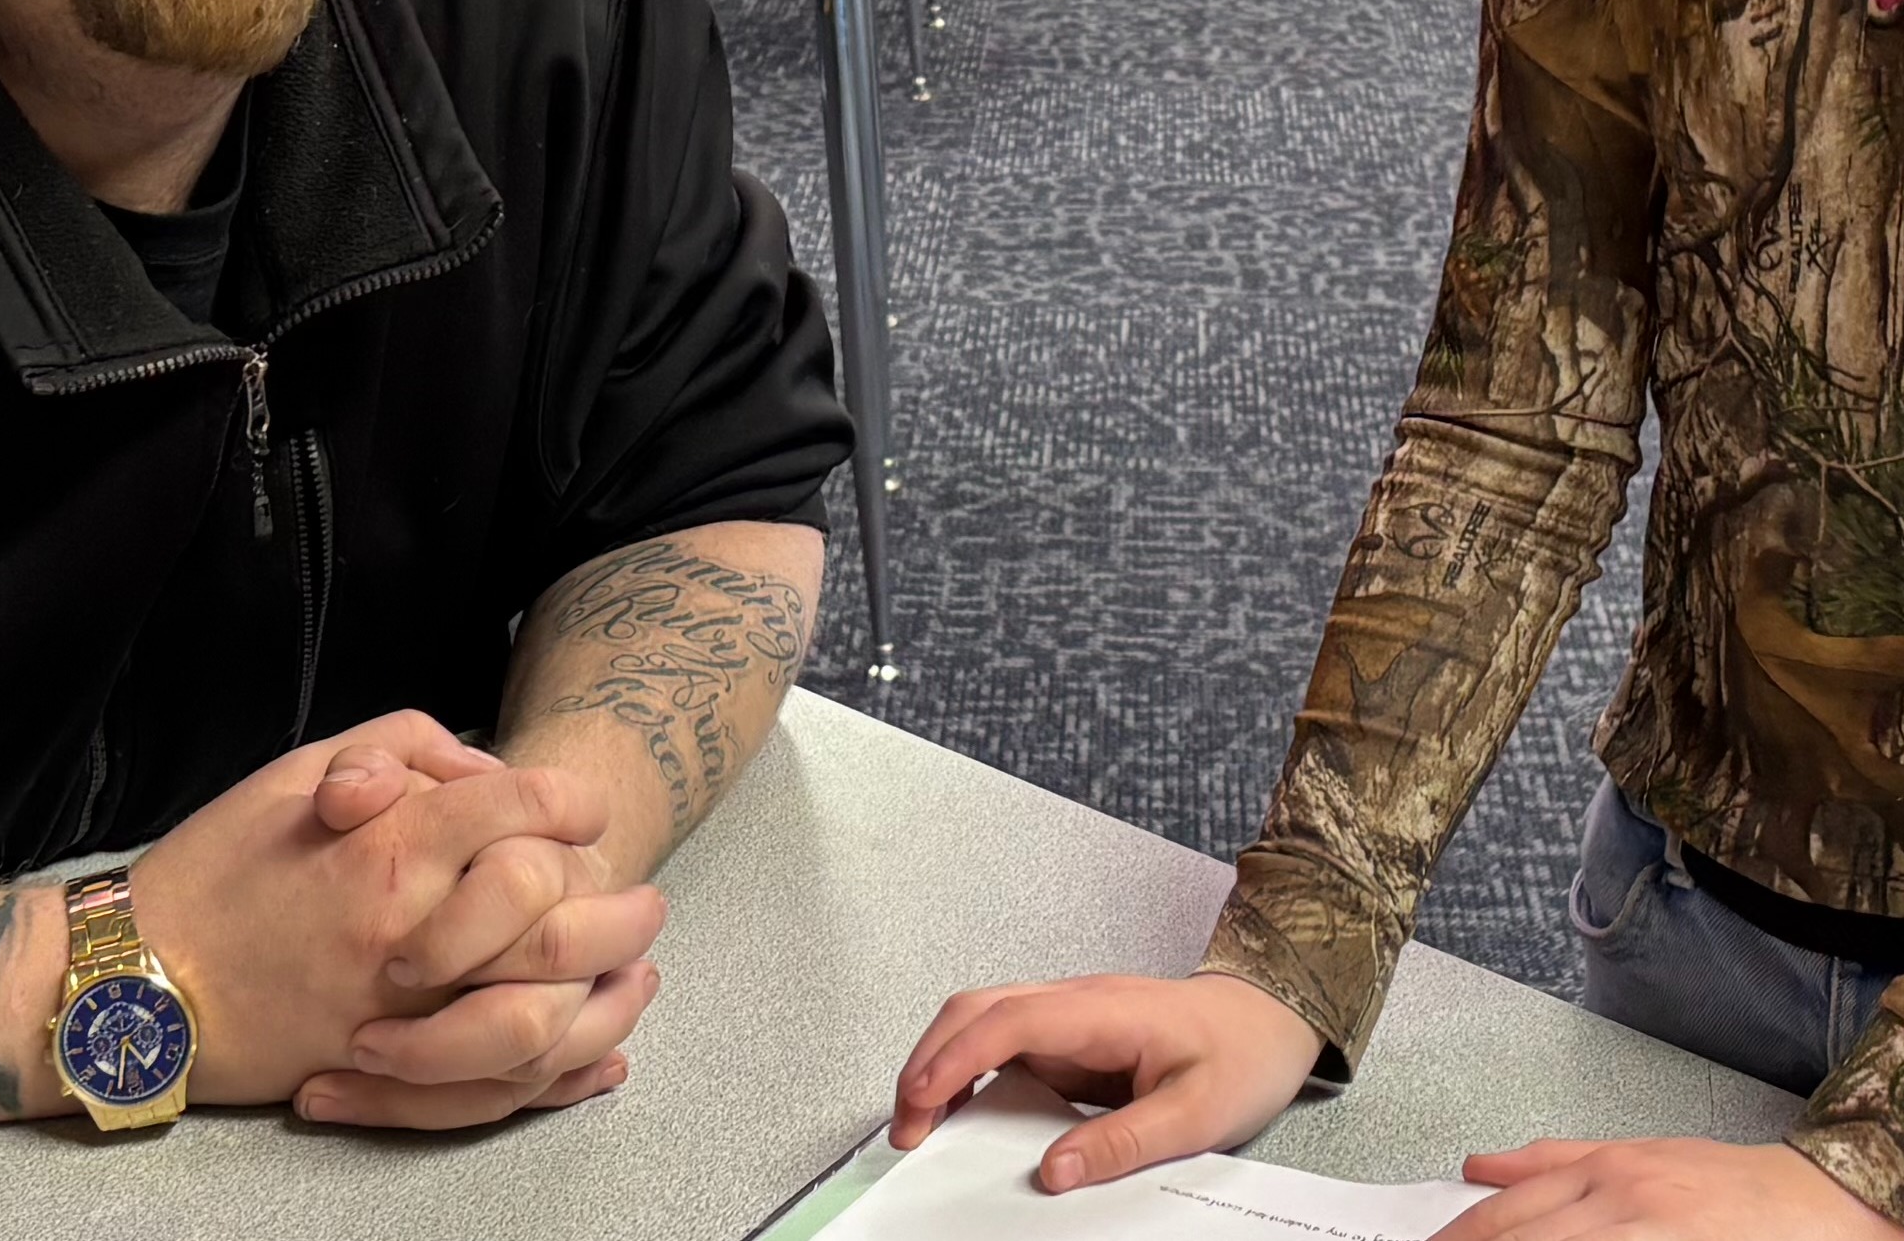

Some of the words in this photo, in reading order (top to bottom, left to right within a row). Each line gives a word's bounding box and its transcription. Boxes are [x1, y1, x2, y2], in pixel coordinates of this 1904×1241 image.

[558, 579, 750, 671] Ruby
[1267, 1214, 1321, 1233] student
[1325, 1224, 1348, 1239] my
